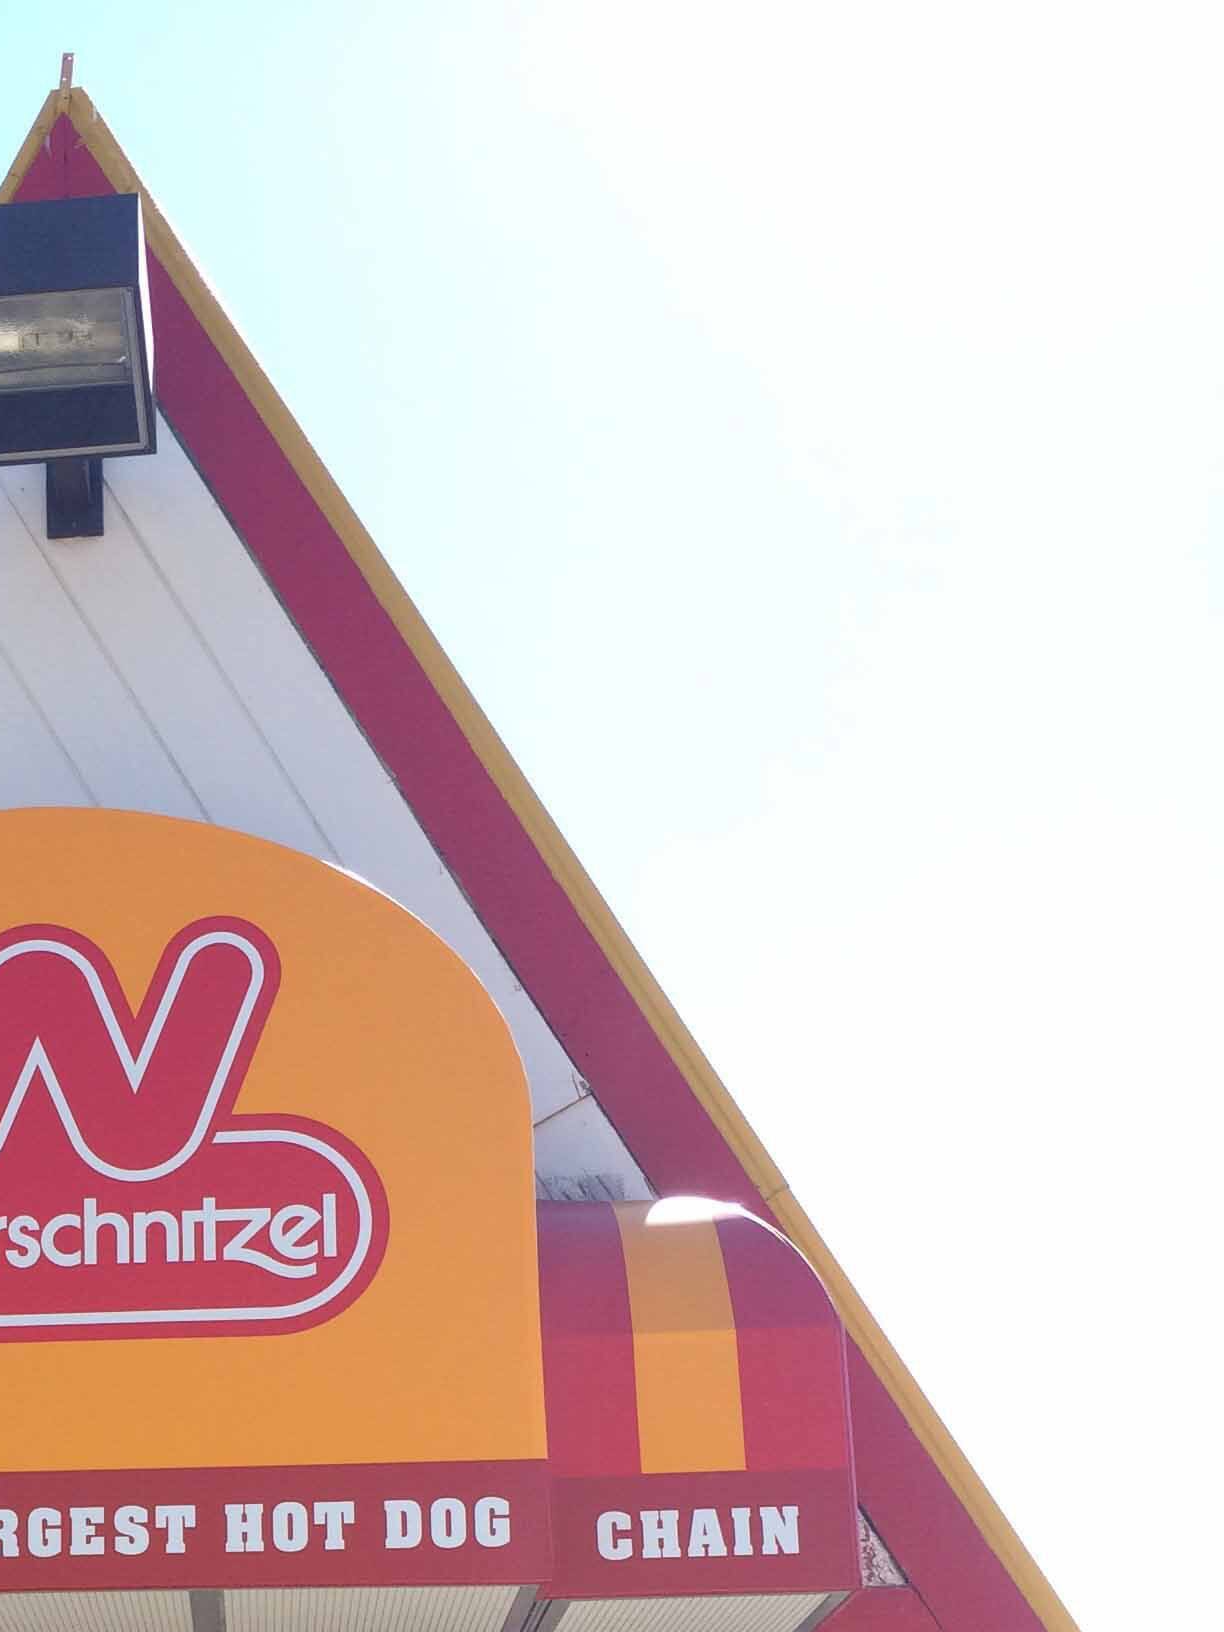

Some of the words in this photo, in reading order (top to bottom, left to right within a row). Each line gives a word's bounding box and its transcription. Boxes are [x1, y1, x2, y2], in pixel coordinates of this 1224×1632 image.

[224, 1500, 355, 1554] HOT
[383, 1496, 512, 1550] DOG
[596, 1504, 801, 1561] CHAIN
